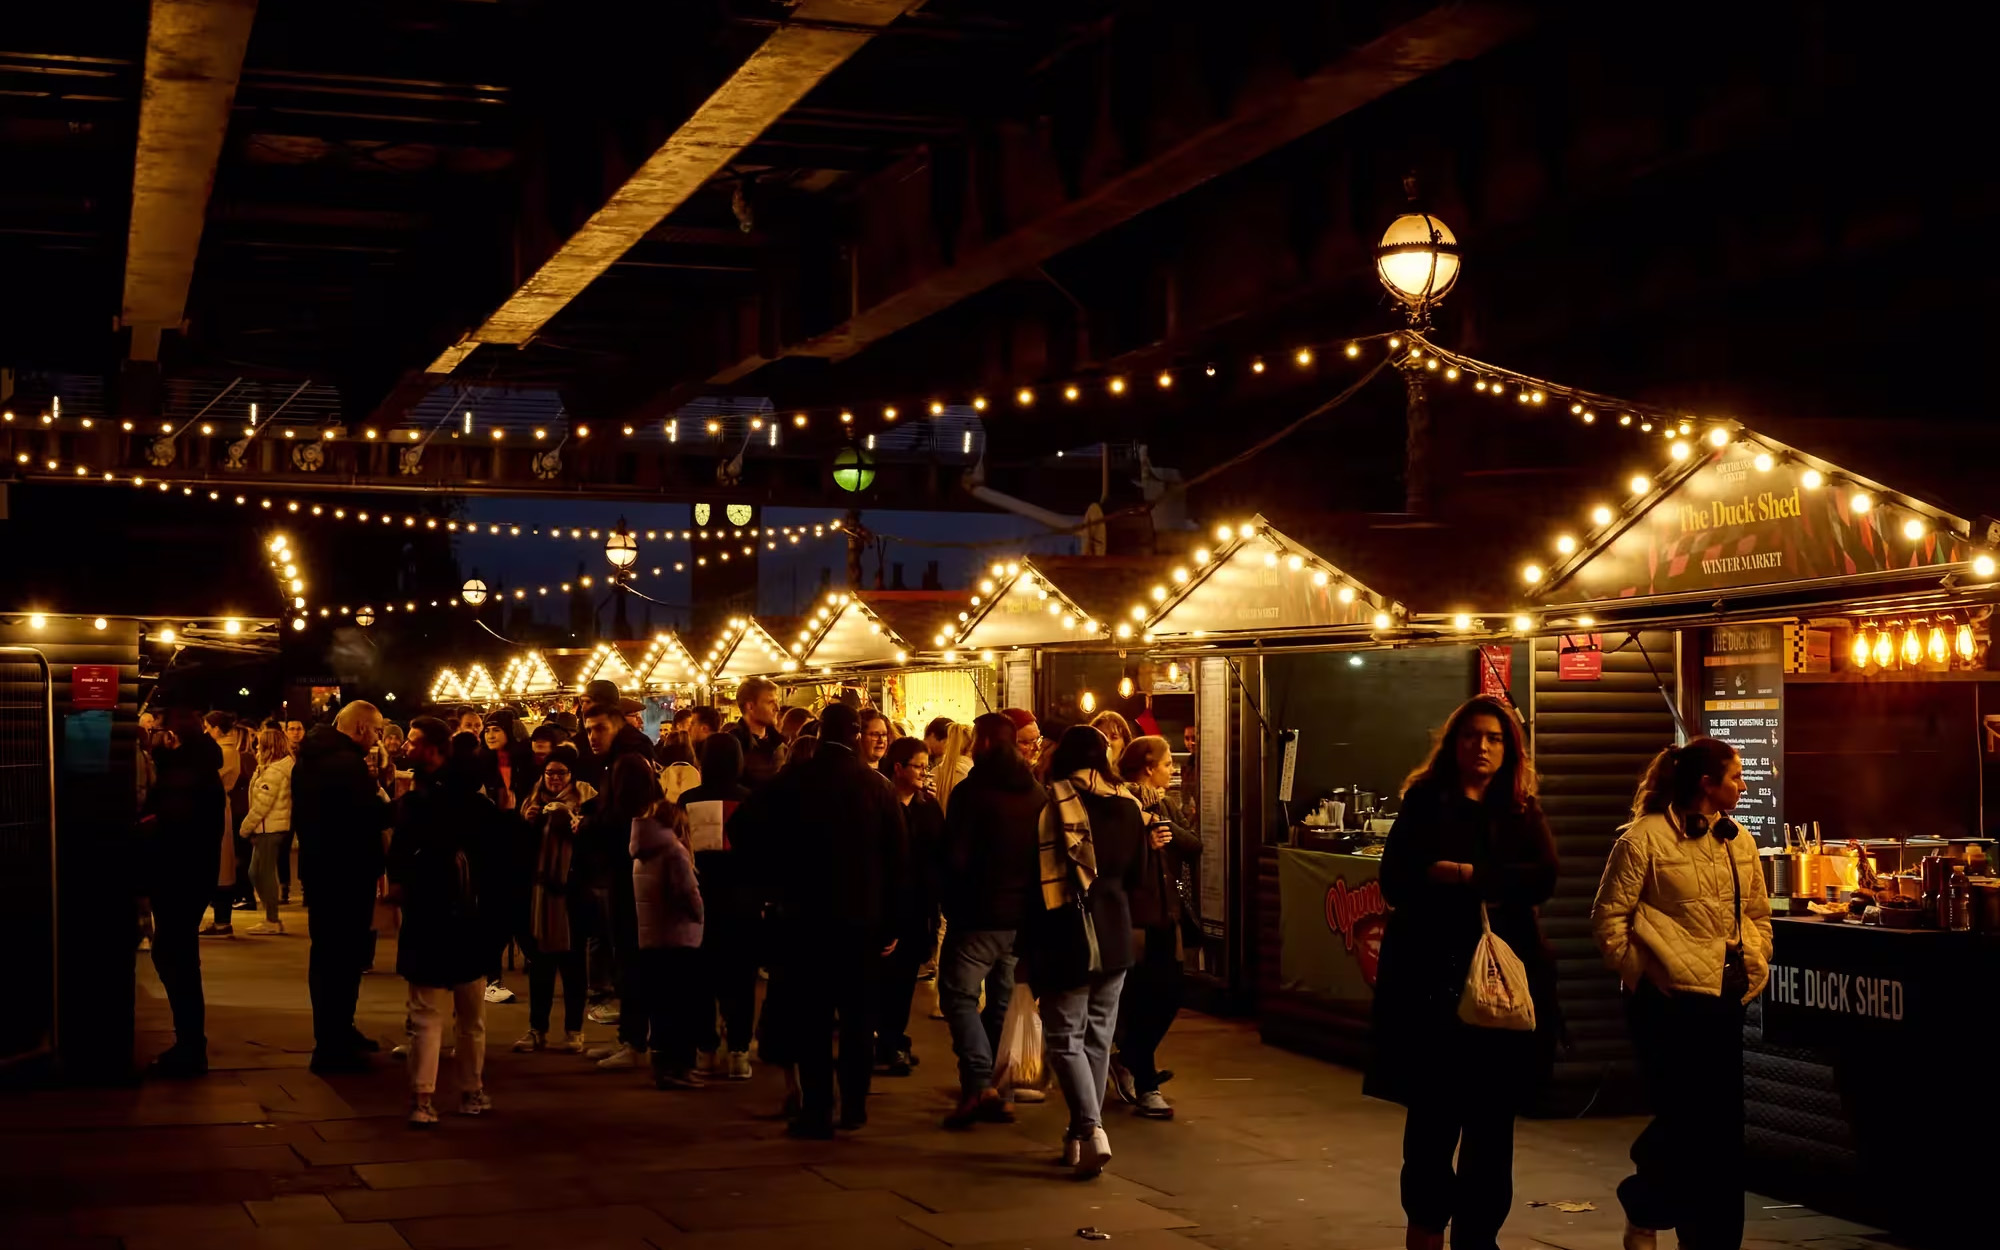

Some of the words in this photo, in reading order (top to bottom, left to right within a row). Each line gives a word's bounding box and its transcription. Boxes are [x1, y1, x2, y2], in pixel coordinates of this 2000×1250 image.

[1681, 504, 1709, 532] The
[1712, 496, 1756, 528] Duck
[1758, 487, 1801, 521] Shed
[1702, 557, 1740, 574] WINTER
[1741, 552, 1782, 571] MARKET
[1713, 633, 1728, 652] THE
[1728, 632, 1749, 651] DUCK
[1750, 631, 1771, 650] SHED
[1709, 719, 1719, 727] THE
[1719, 719, 1738, 727] BRITISH
[1738, 718, 1764, 726] CHRISTMAS
[1765, 718, 1779, 727] £12.5
[1709, 728, 1730, 737] QUACKER
[1760, 757, 1770, 766] £11
[1758, 787, 1772, 796] £12.5
[1767, 816, 1777, 825] £11
[1769, 964, 1799, 1005] THE
[1805, 969, 1850, 1012] DUCK
[1856, 976, 1903, 1020] SHED
